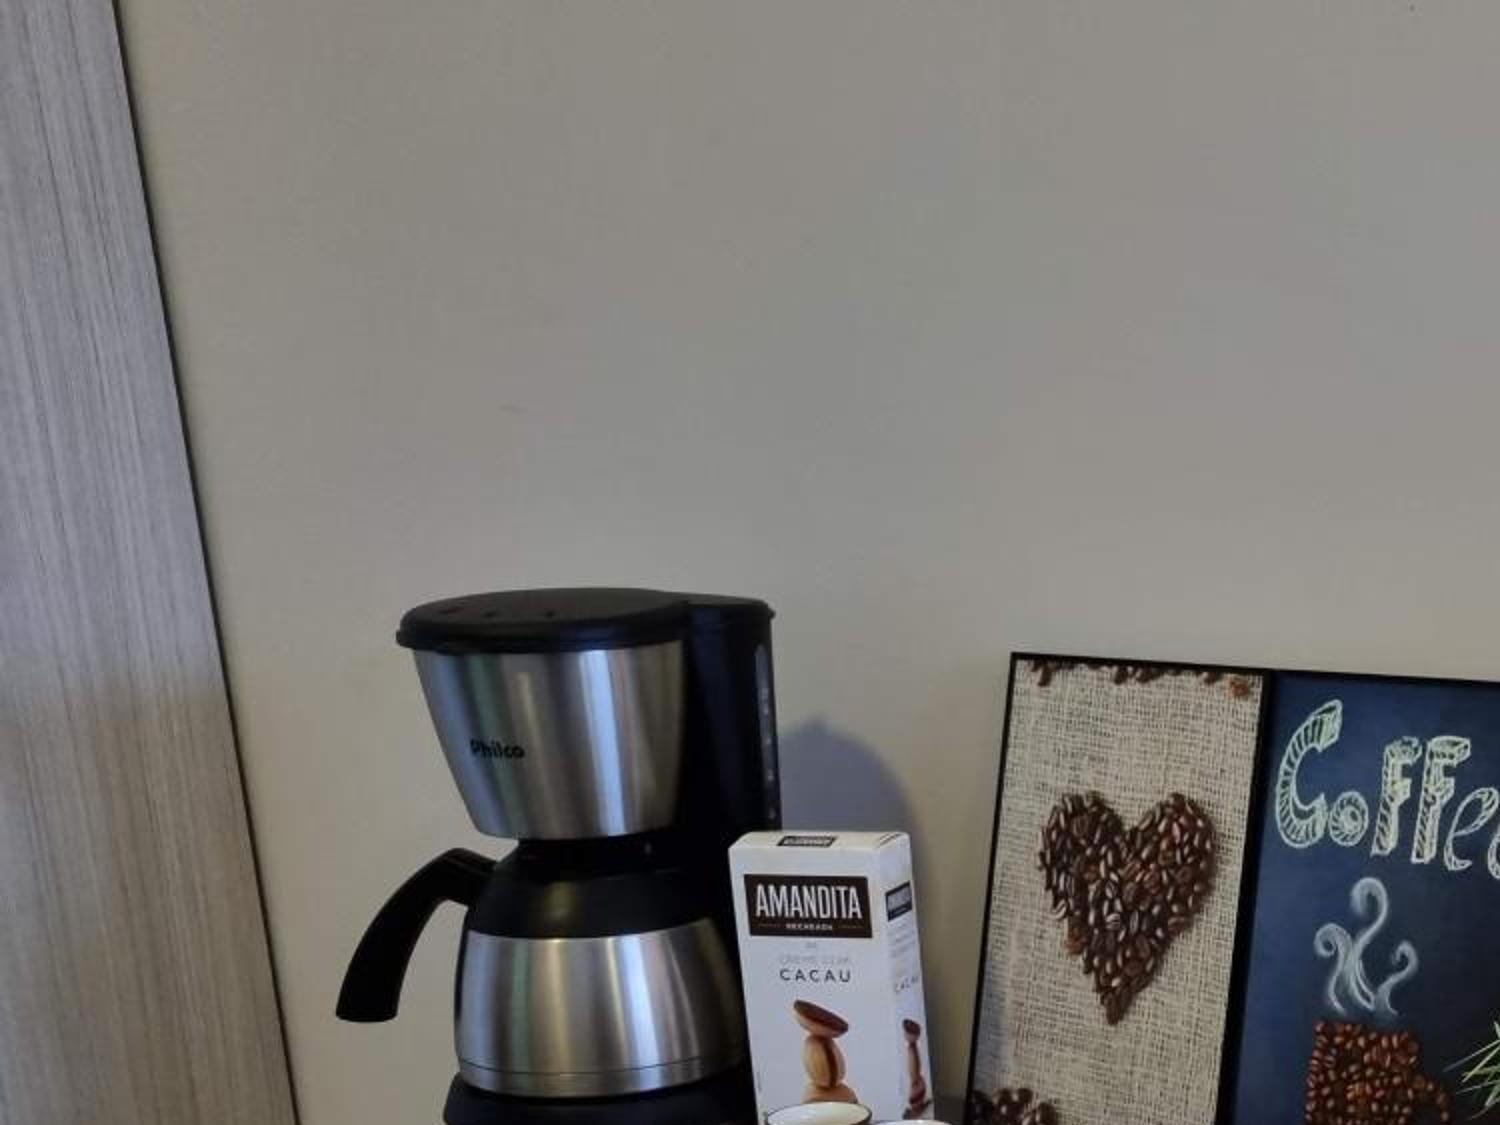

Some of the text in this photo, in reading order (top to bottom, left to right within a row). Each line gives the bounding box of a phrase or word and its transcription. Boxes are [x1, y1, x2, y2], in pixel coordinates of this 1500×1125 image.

[469, 739, 525, 758] Philco
[755, 883, 863, 919] AMANDITA
[779, 968, 851, 983] CACAU
